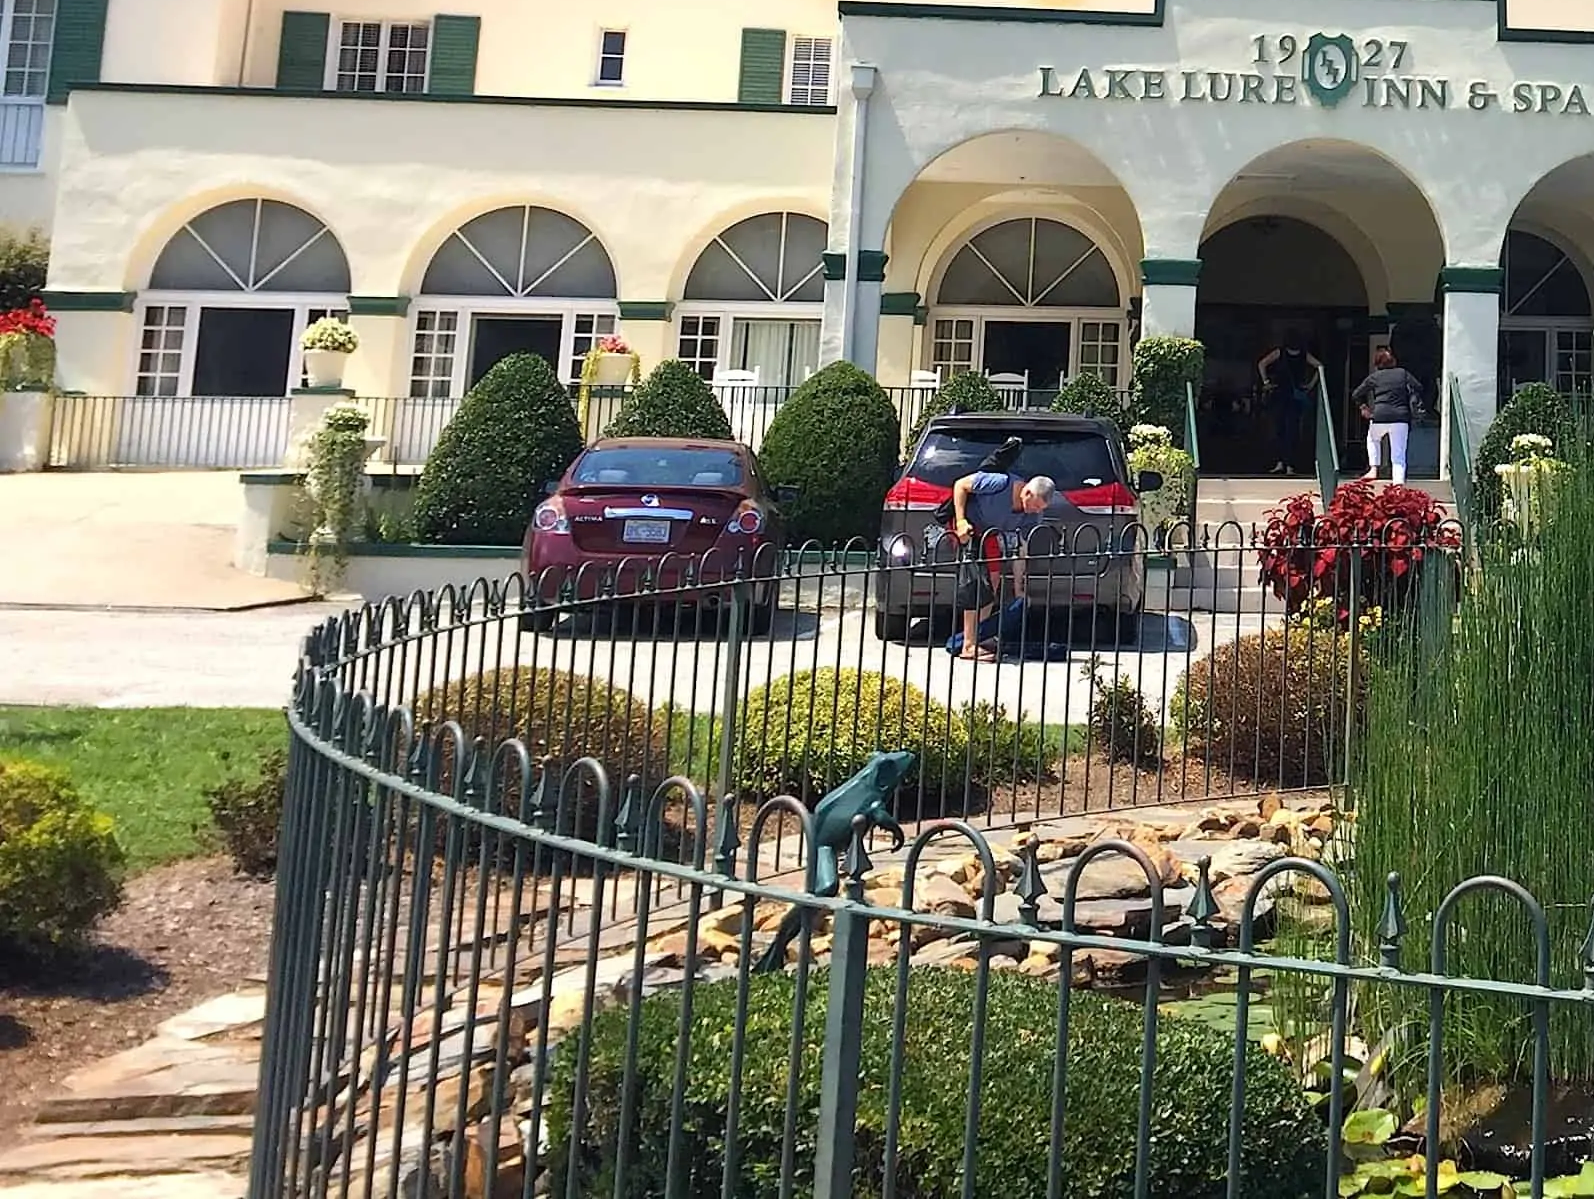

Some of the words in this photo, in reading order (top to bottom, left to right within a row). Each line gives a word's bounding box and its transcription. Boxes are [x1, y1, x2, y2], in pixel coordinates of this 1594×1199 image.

[1038, 67, 1165, 101] LAKE
[1180, 71, 1297, 104] LURE
[1362, 76, 1448, 109] INN
[1468, 81, 1498, 111] &
[1513, 82, 1592, 116] SPA
